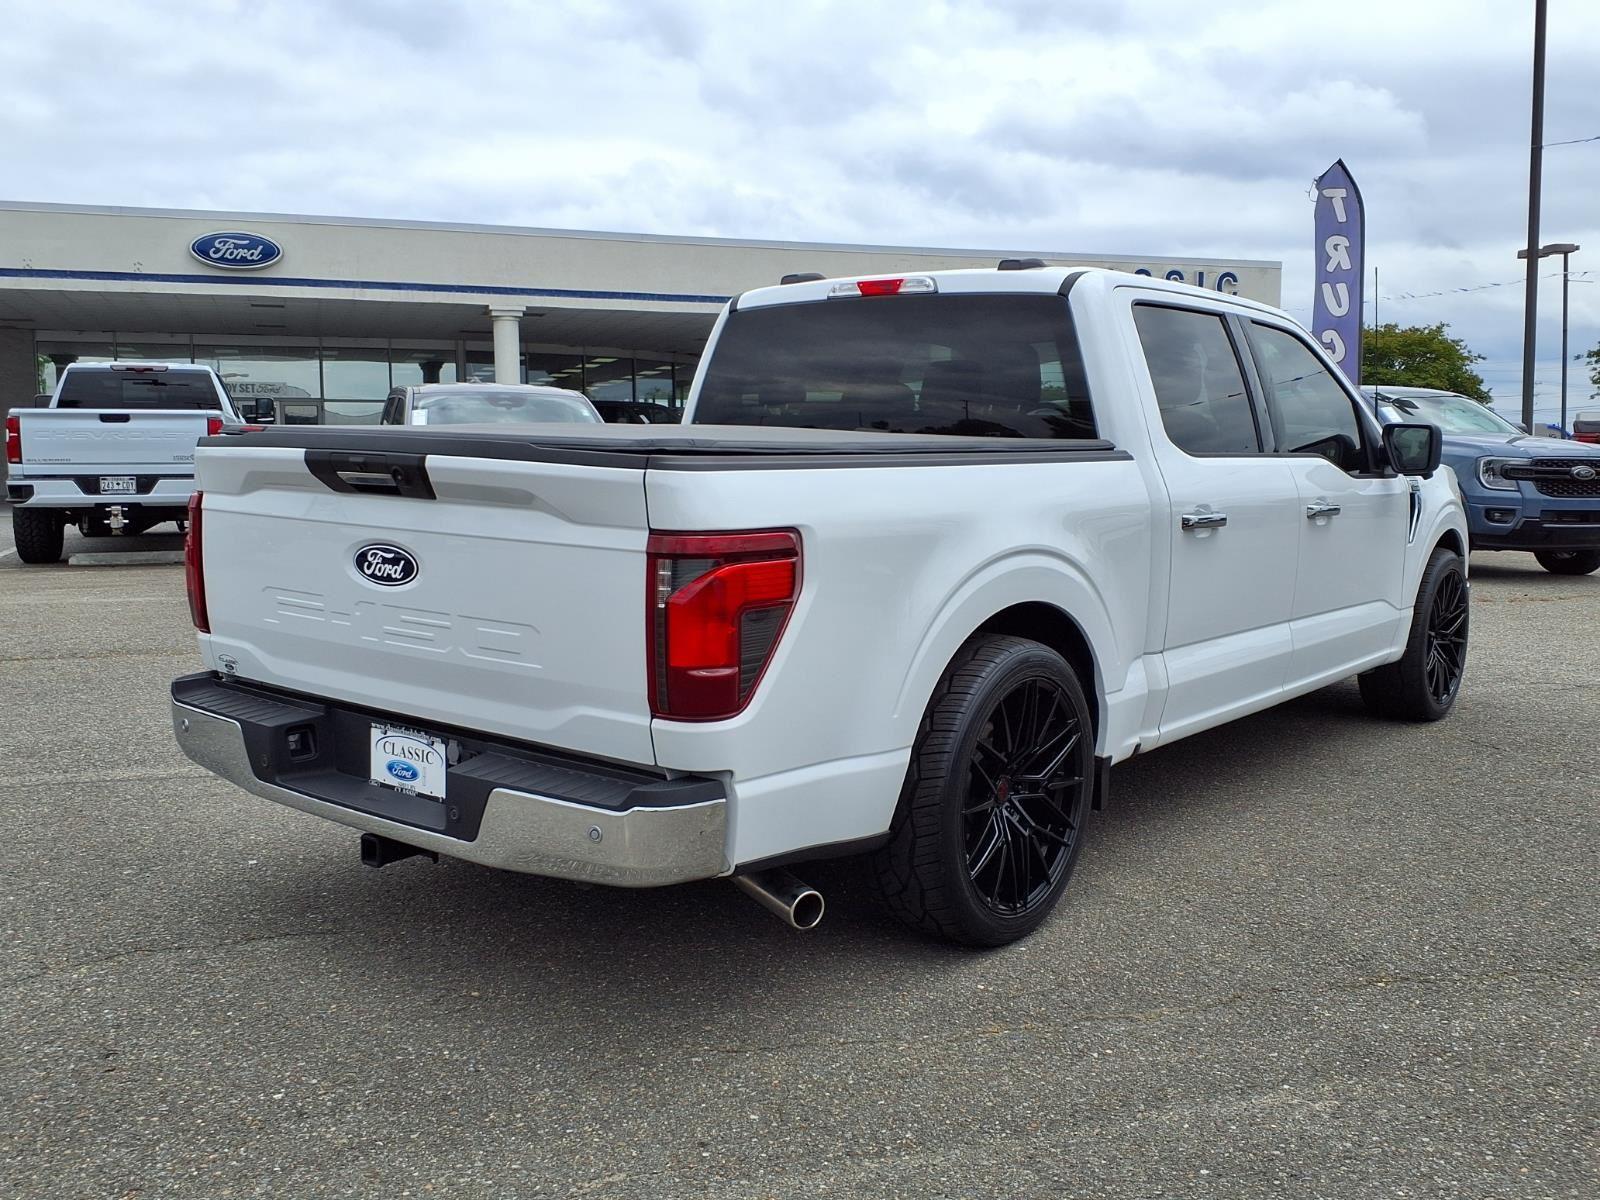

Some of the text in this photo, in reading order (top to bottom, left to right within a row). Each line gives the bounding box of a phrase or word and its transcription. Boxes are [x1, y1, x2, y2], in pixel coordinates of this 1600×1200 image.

[209, 238, 262, 260] Ford
[239, 383, 256, 393] SET
[32, 430, 194, 440] CHEVROLET
[364, 550, 404, 579] Ford
[262, 586, 543, 668] F-150
[383, 740, 435, 765] CLASSIC
[392, 763, 413, 779] Ford
